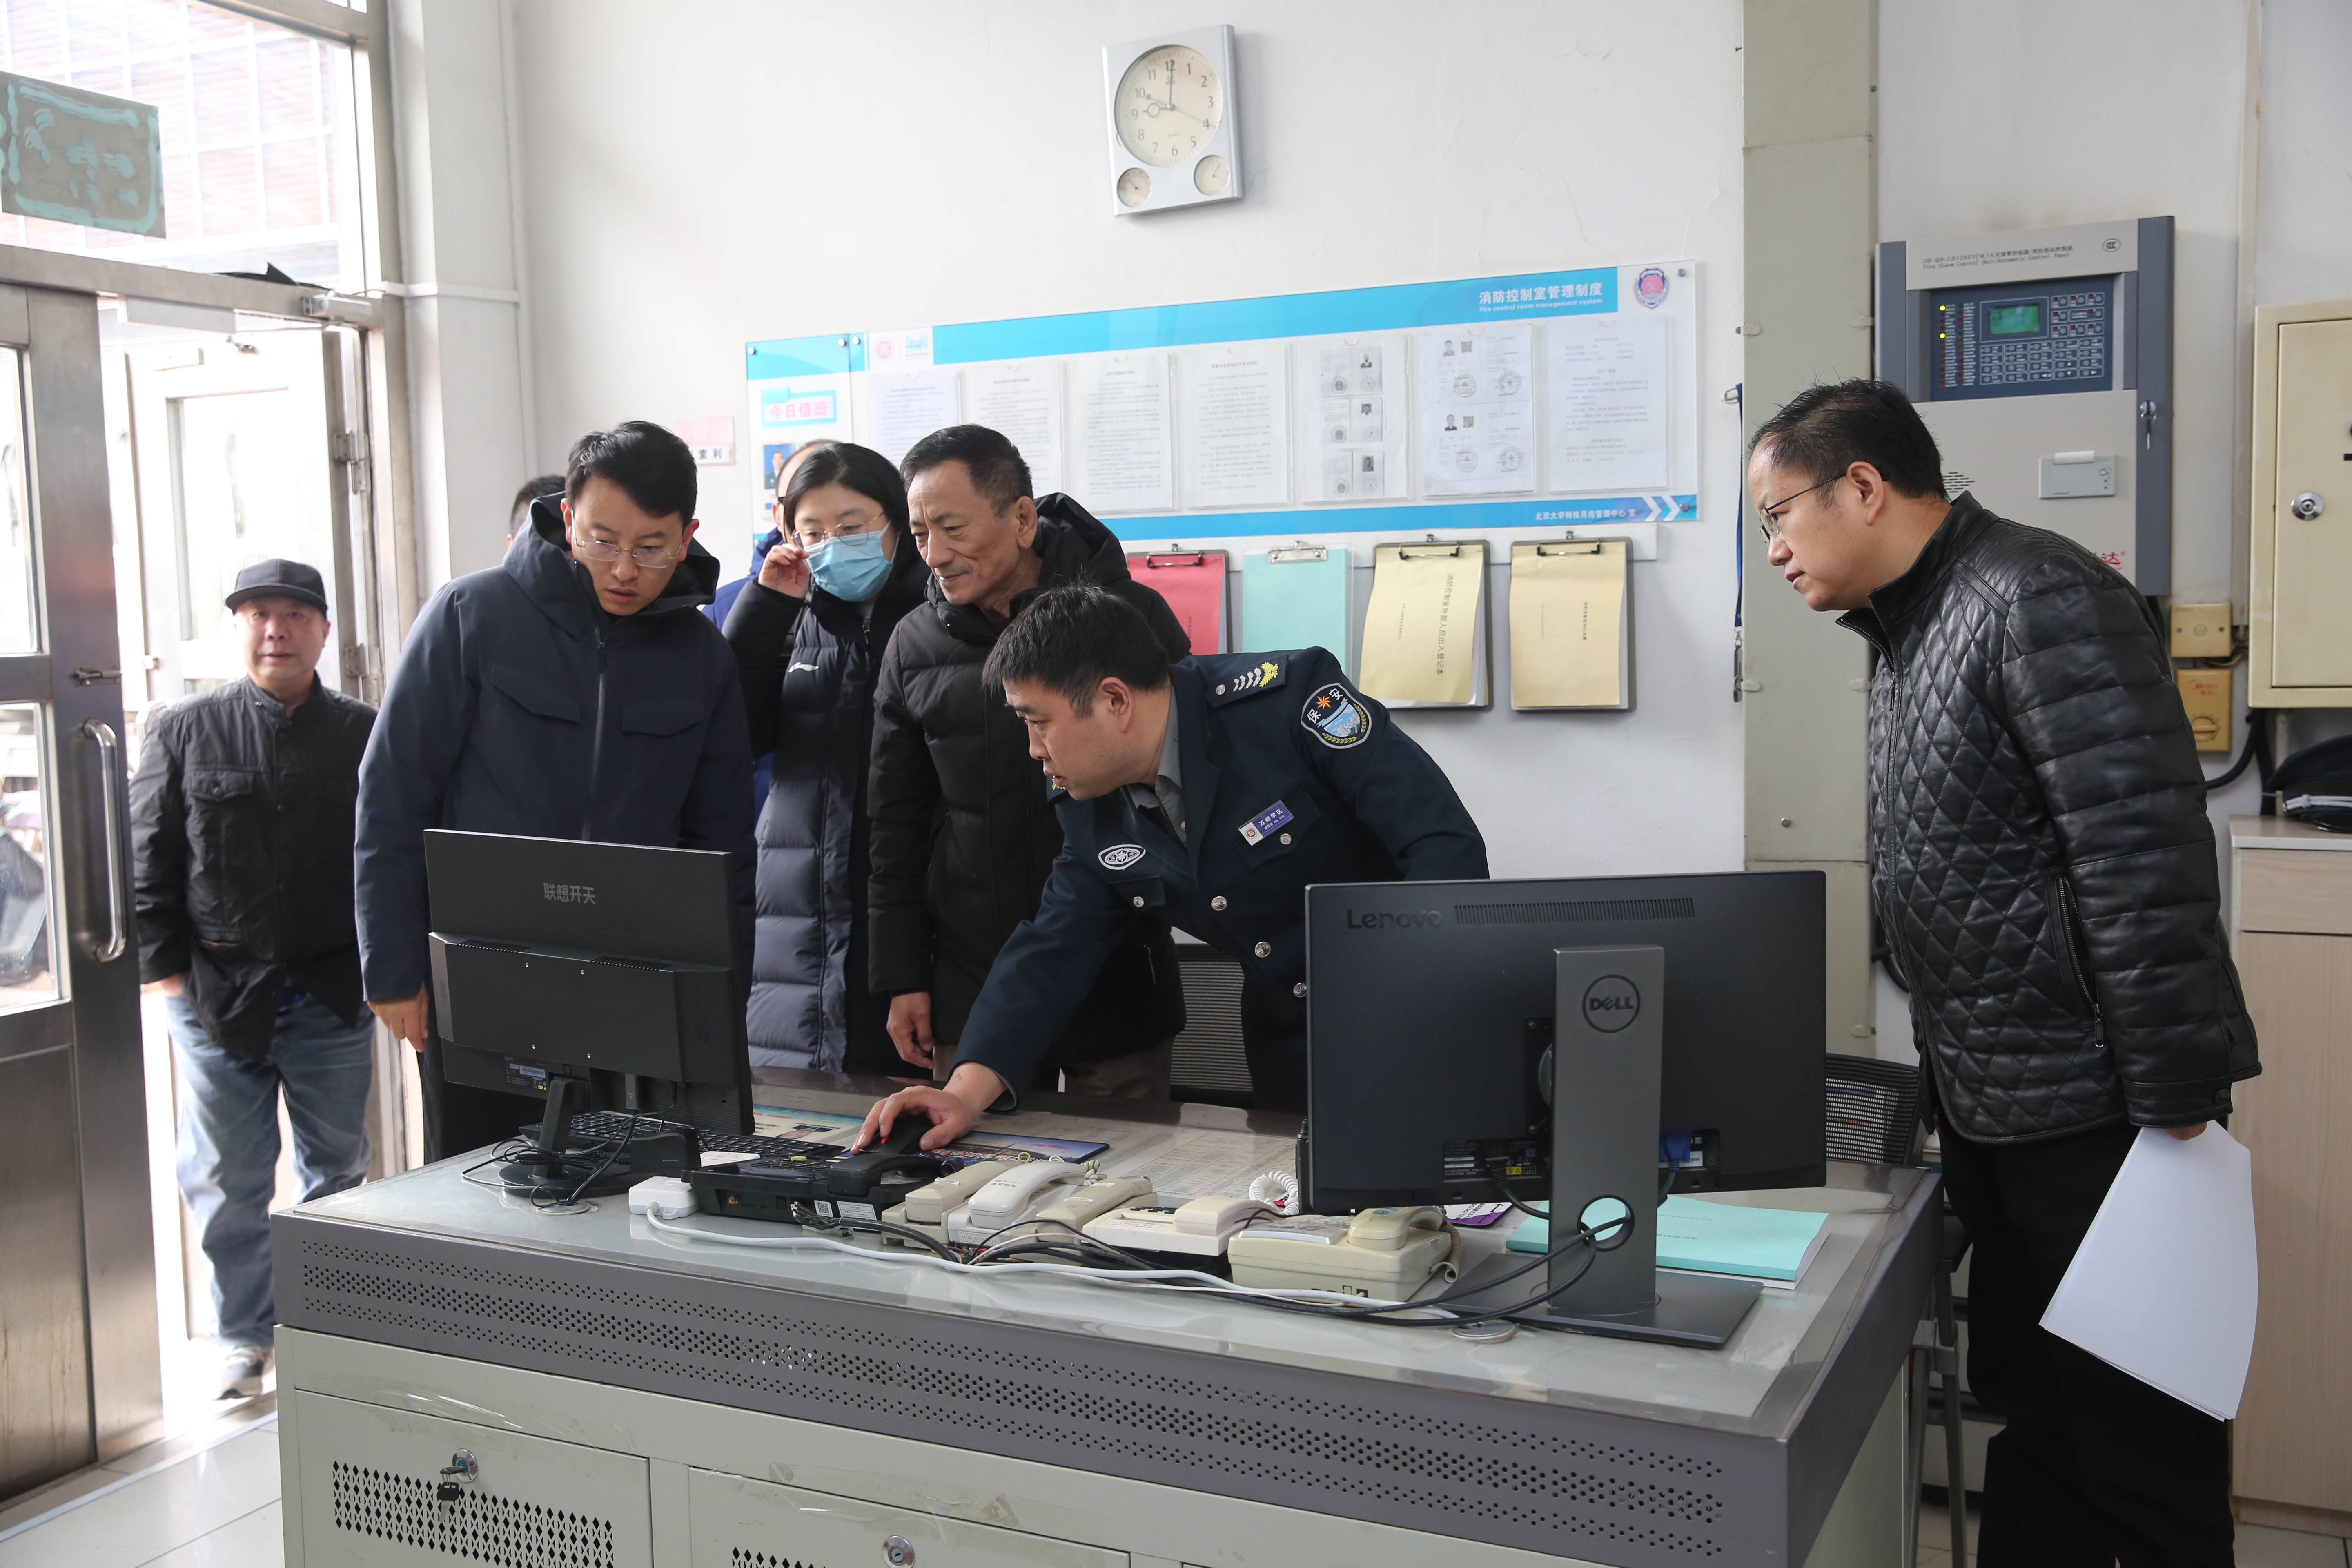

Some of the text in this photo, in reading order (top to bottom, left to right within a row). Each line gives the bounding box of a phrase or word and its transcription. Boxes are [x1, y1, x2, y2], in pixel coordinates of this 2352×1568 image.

[1165, 61, 1175, 71] 12
[1187, 63, 1191, 75] 1
[1147, 69, 1156, 80] 11
[1201, 75, 1207, 88] 2
[1134, 87, 1145, 99] 10
[1208, 96, 1213, 108] 3
[1132, 109, 1138, 120] 9
[1203, 118, 1210, 129] 4
[1138, 129, 1144, 141] 8
[1152, 142, 1158, 154] 7
[1190, 136, 1196, 148] 5
[1172, 145, 1178, 157] 6
[1479, 282, 1602, 304] 消防控制室管理制度
[770, 401, 828, 420] 今日值班
[1535, 510, 1626, 520] 北京大学特殊用房管理中心
[1436, 573, 1454, 676] 消防控制室外部人员出入登记本
[1258, 808, 1283, 826] 万柳学区
[543, 882, 596, 905] 联想开天
[1347, 909, 1443, 929] Lenovo
[1589, 996, 1634, 1012] DELL
